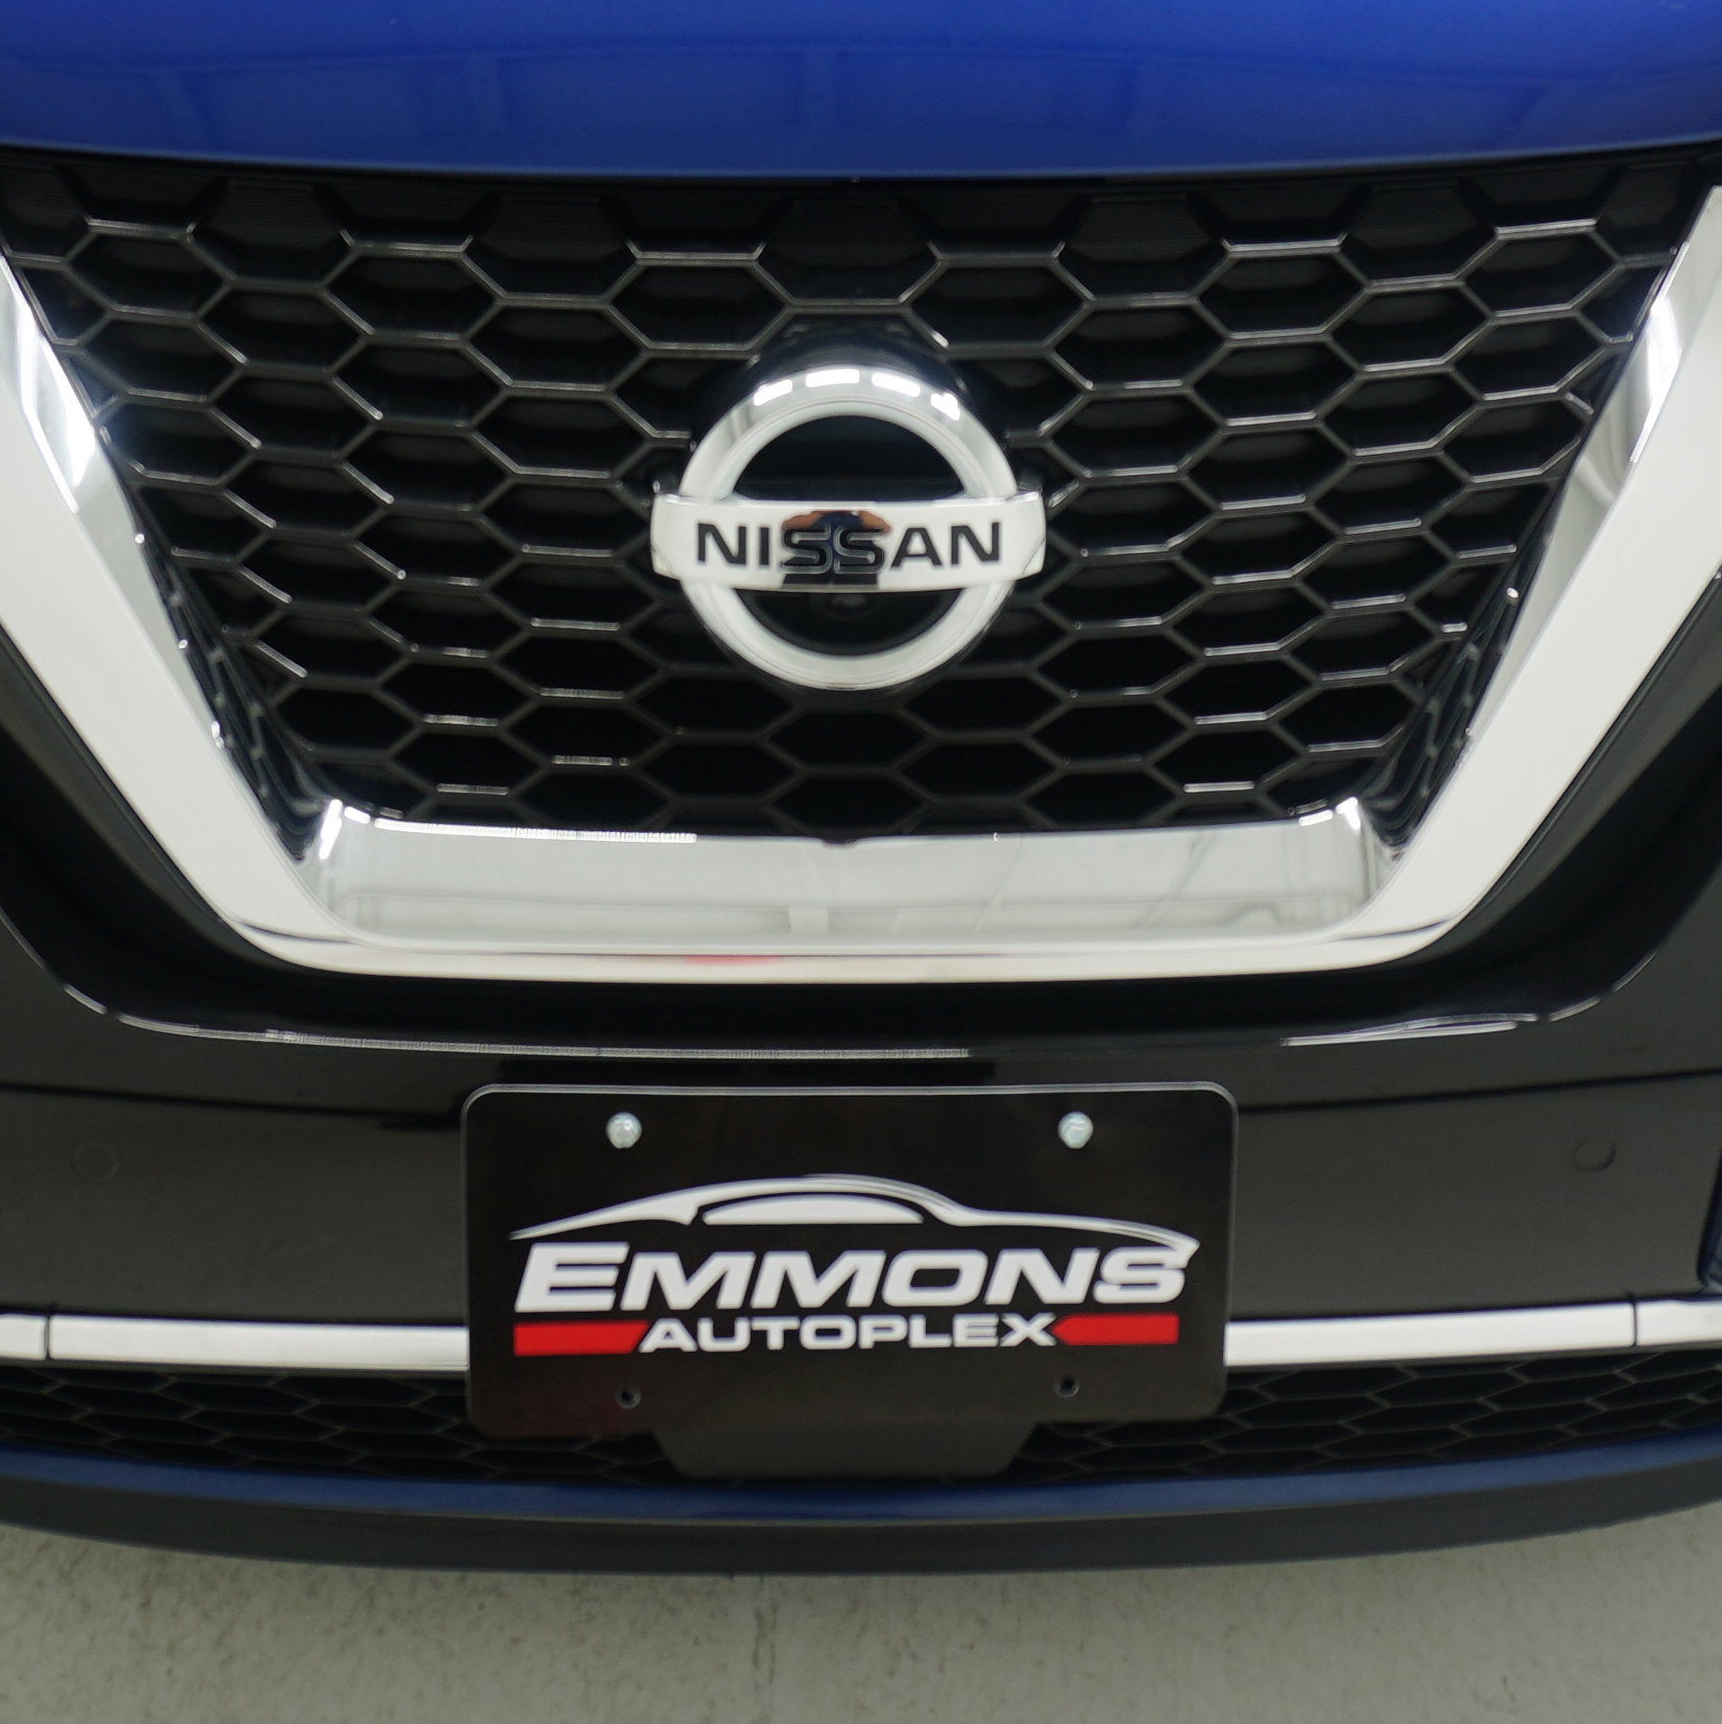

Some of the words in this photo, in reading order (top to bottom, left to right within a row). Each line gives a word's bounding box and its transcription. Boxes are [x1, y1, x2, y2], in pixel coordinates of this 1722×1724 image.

[696, 521, 1001, 575] NISSAN
[514, 1242, 1187, 1313] EMMONS
[639, 1314, 1056, 1353] AUTOPLEX
